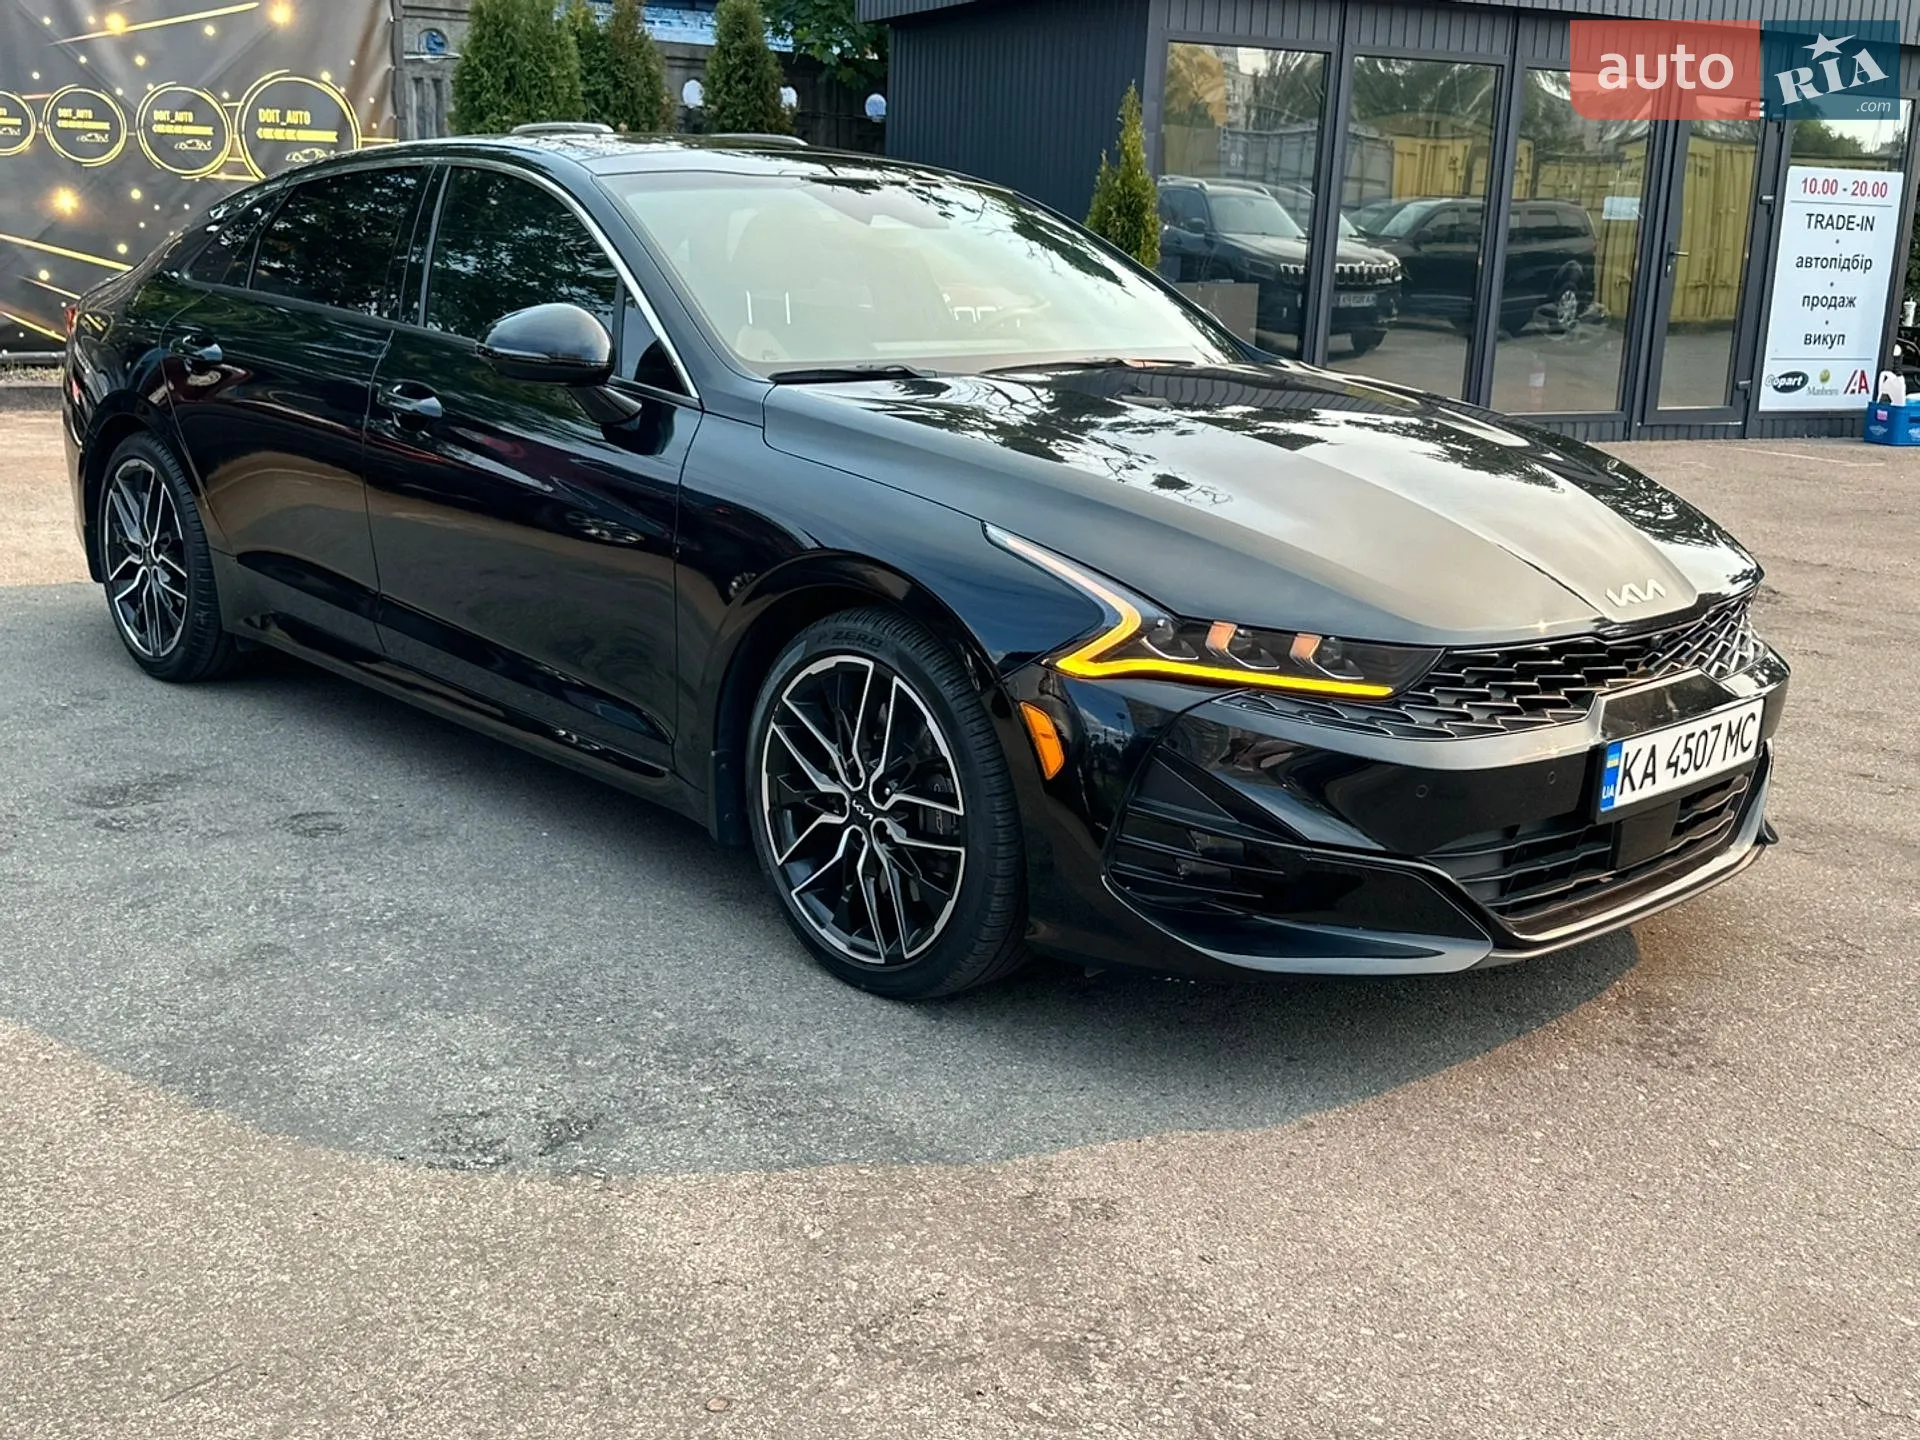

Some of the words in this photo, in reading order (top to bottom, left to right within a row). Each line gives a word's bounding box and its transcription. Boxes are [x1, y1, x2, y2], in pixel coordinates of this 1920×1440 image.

[258, 108, 311, 126] DOIT_AUTO
[1801, 177, 1838, 196] 10.00
[1851, 181, 1888, 198] 20.00
[1806, 213, 1875, 232] TRADE-IN
[1796, 254, 1873, 274] автопідбір
[1802, 294, 1857, 311] продаж
[1804, 333, 1846, 349] викуп
[832, 631, 883, 648] ZERO
[1619, 744, 1656, 797] KA
[1666, 723, 1722, 779] 4507
[1722, 712, 1756, 762] MC
